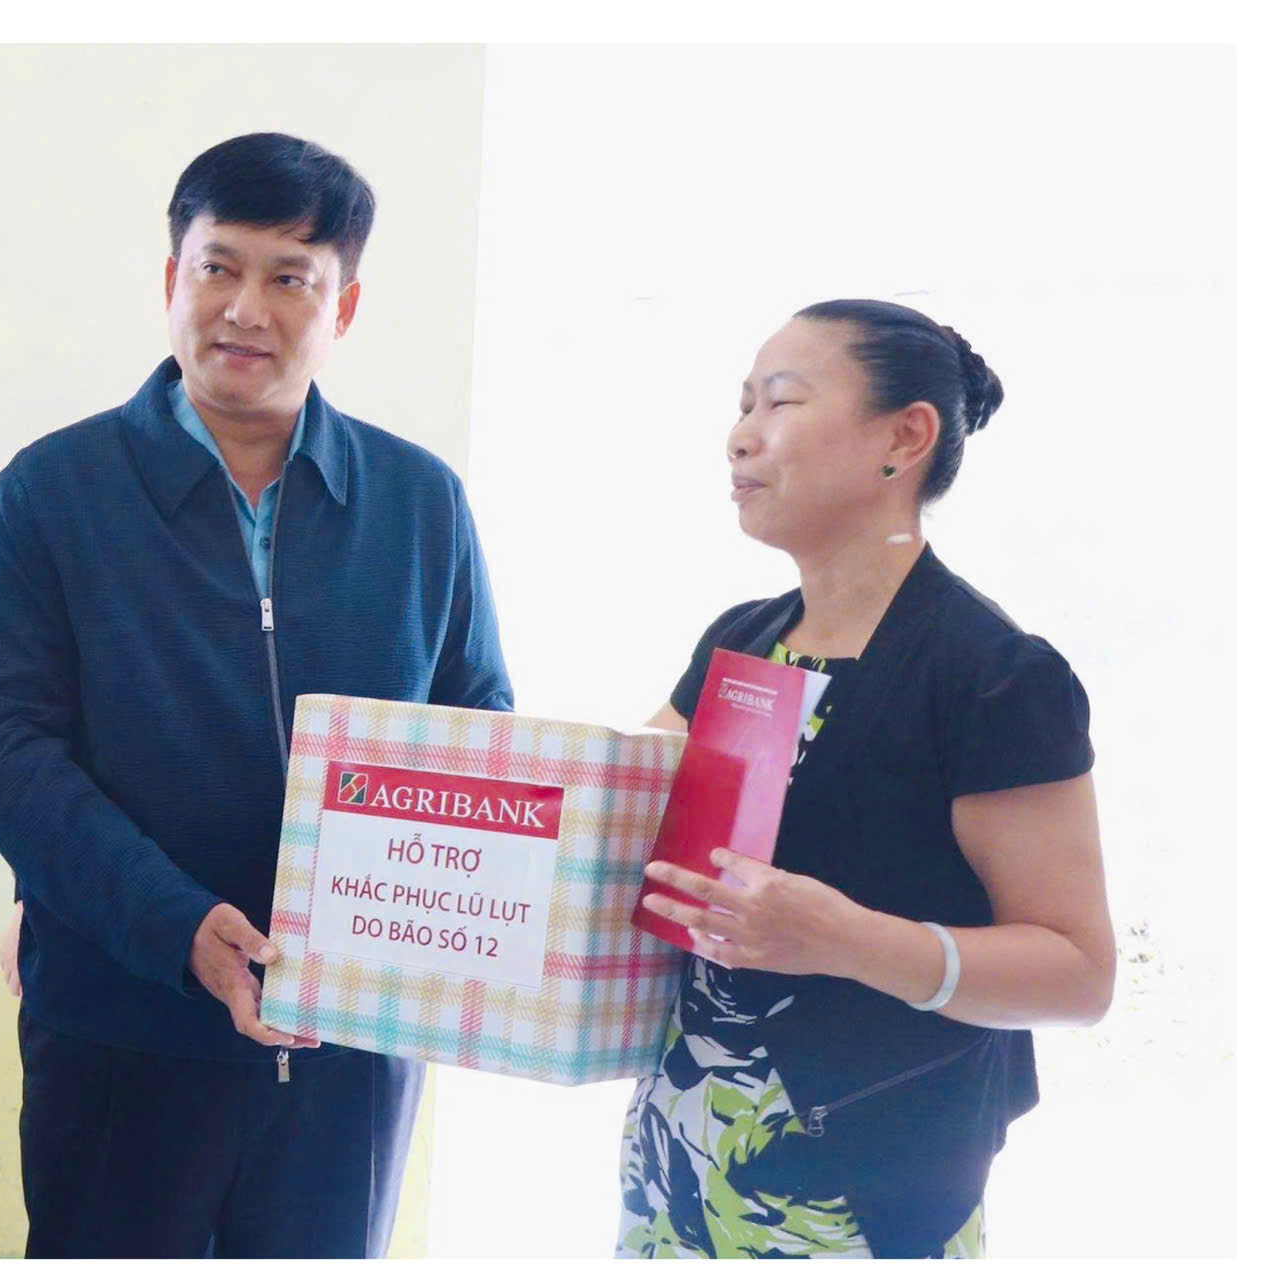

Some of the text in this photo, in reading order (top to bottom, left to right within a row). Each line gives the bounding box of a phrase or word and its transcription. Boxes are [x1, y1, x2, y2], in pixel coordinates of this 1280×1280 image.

[371, 784, 545, 828] AGRIBANK
[387, 833, 482, 878] HỖ TRỢ
[331, 874, 531, 927] KHẮC PHỤC LŨ LỤT
[352, 915, 498, 957] DO BÃO SỐ 12
